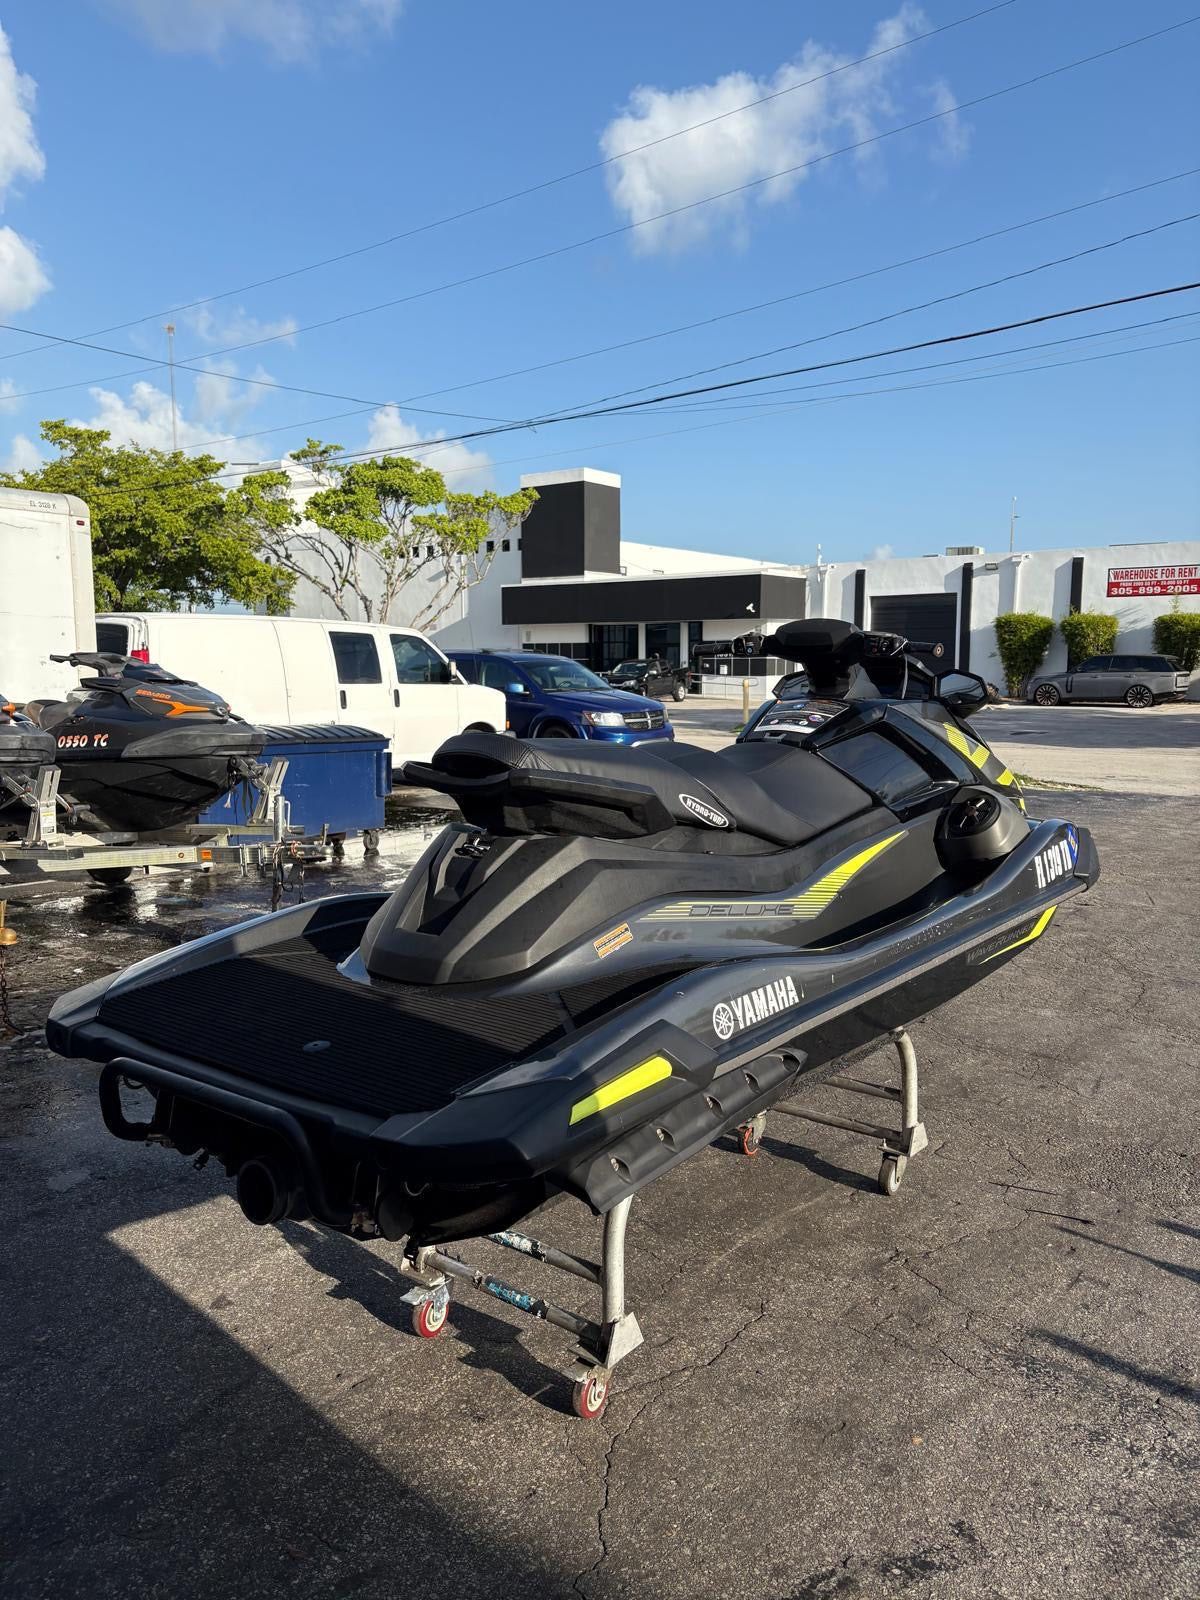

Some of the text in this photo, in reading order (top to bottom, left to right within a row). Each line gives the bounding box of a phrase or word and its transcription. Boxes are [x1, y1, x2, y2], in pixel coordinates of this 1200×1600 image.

[1113, 567, 1198, 580] WAREHOUSE FOR RENT
[1111, 585, 1198, 595] 305-899-2005
[57, 733, 109, 749] 0550 TC
[686, 797, 725, 826] HYDRO-TURF
[1034, 855, 1047, 889] FL
[688, 904, 795, 917] DELUXE
[731, 975, 799, 1030] YAMAHA
